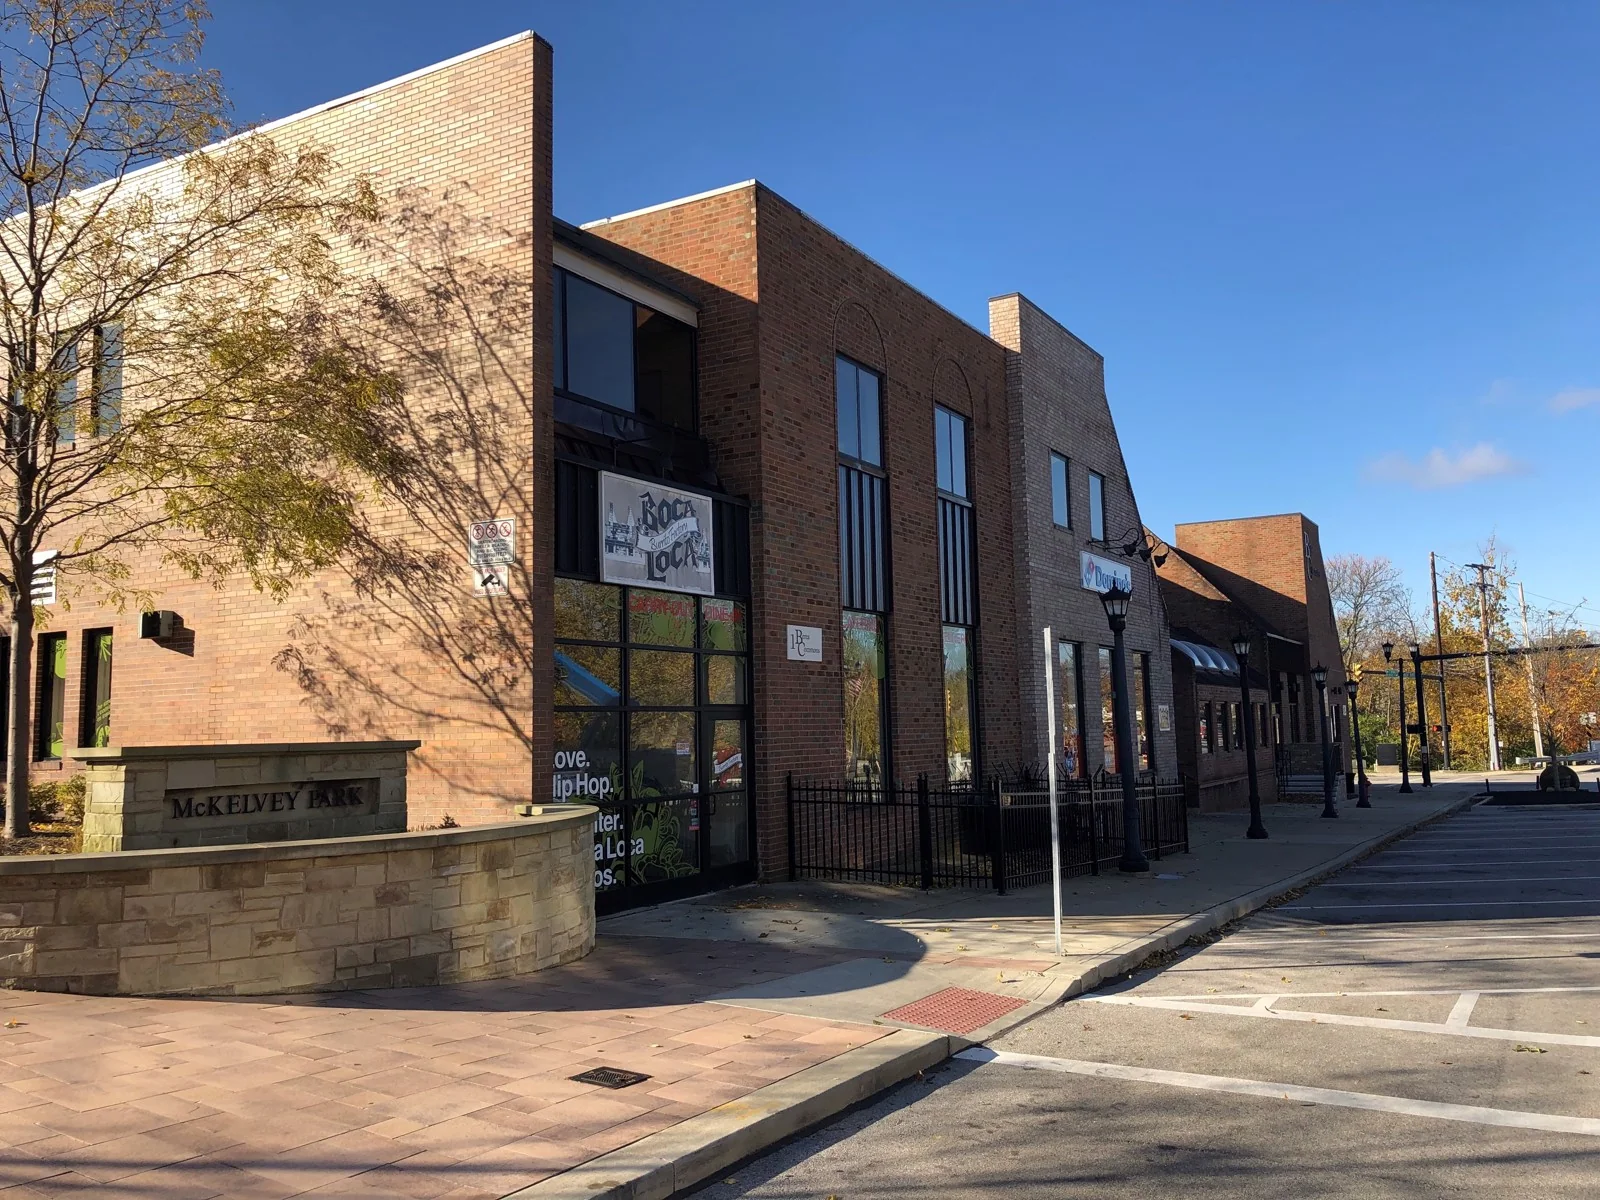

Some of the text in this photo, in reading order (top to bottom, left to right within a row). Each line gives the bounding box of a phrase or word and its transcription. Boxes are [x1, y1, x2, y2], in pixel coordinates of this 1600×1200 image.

[638, 491, 697, 534] BOCA
[647, 537, 698, 583] LOCA
[1095, 565, 1131, 591] Domno's
[552, 750, 591, 769] ove.
[576, 772, 614, 800] Hop.
[172, 786, 365, 819] McKELVEY PARK
